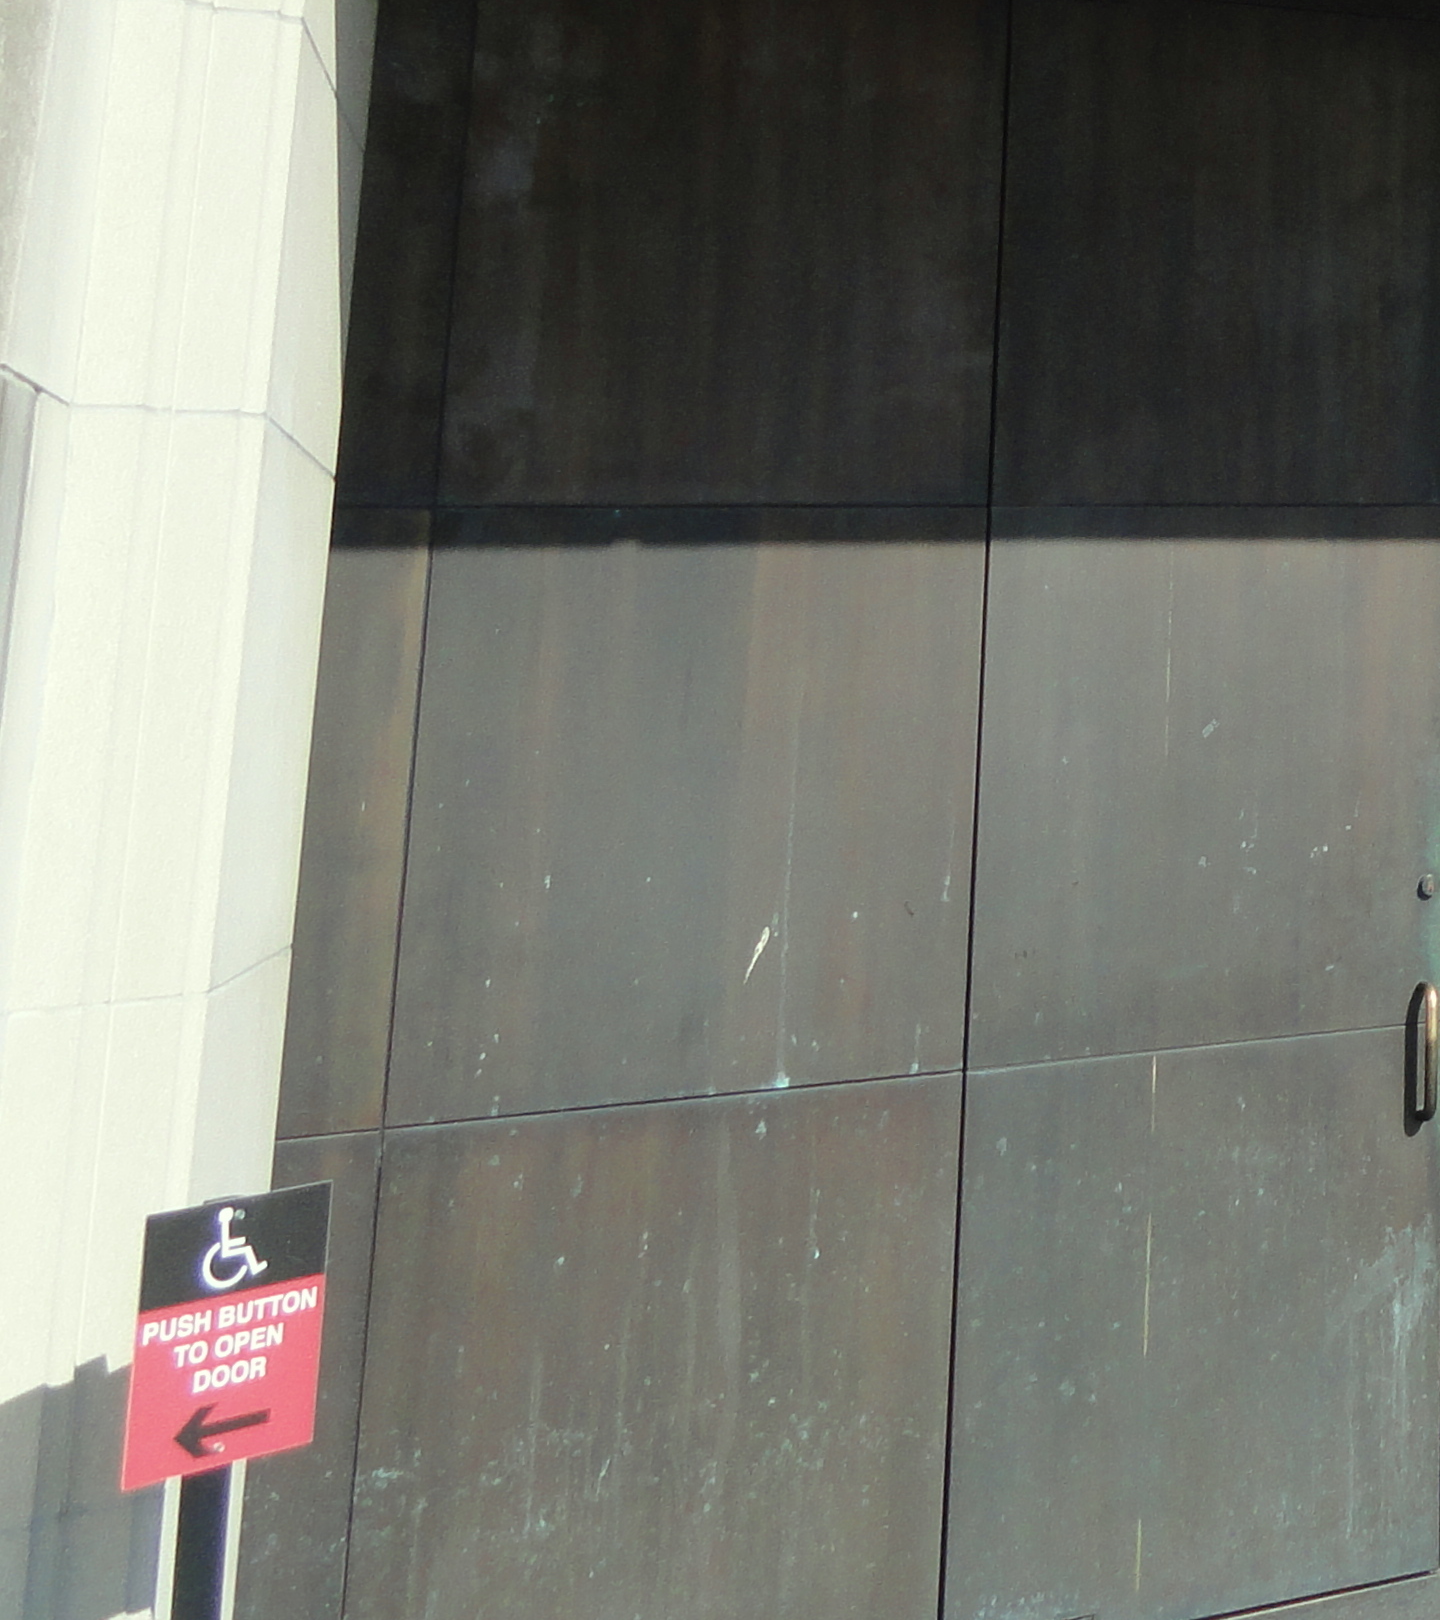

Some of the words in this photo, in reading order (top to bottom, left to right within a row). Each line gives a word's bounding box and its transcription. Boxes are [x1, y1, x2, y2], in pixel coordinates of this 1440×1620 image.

[141, 1309, 213, 1347] PUSH
[217, 1285, 319, 1329] BUTTON
[173, 1341, 209, 1369] TO
[214, 1322, 285, 1358] OPEN
[191, 1355, 268, 1395] DOOR
